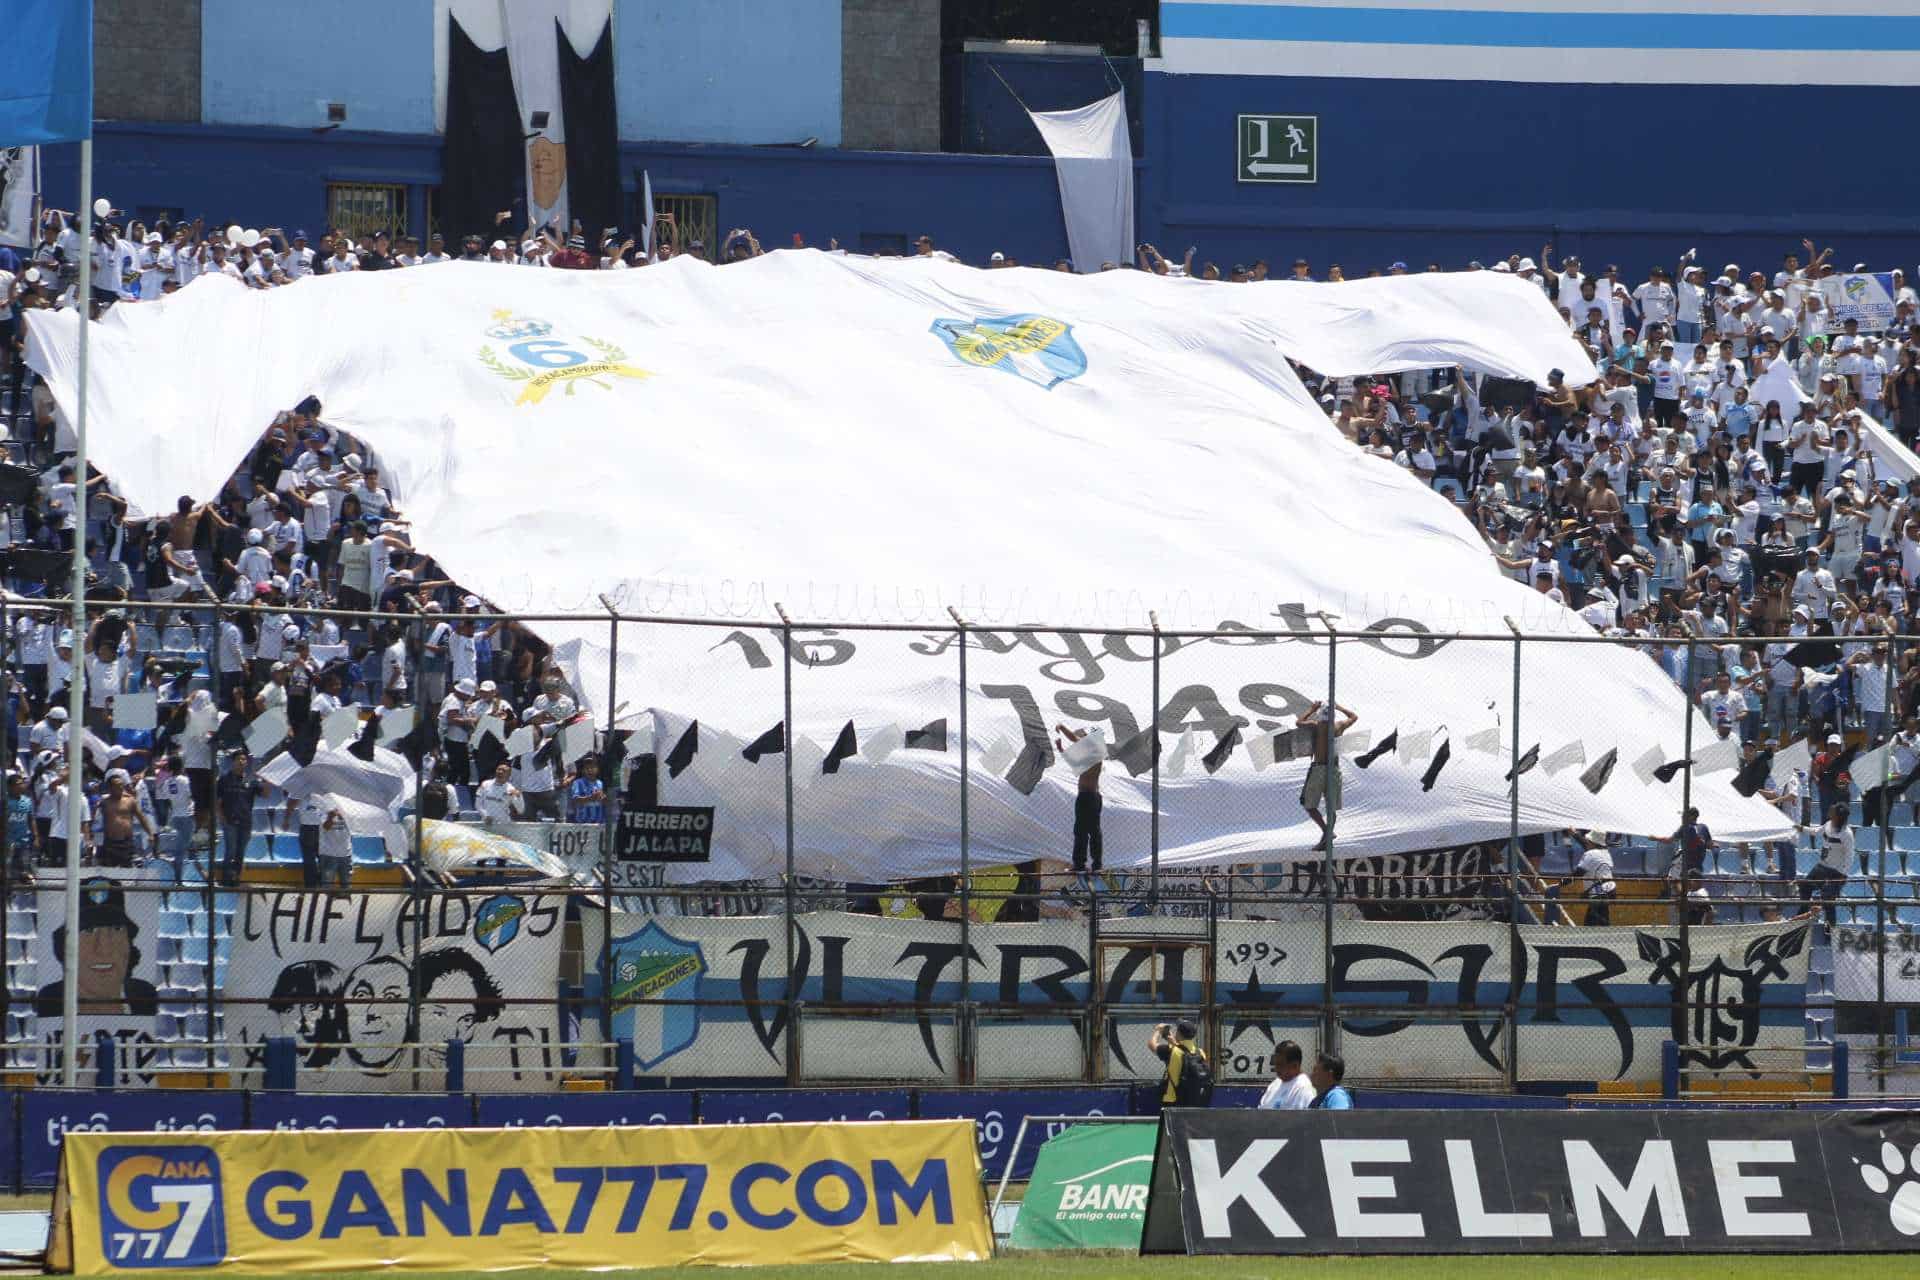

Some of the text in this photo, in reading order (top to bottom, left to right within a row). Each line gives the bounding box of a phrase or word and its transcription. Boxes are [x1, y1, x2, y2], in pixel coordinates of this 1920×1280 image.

[508, 340, 588, 368] 6
[708, 625, 856, 669] 16
[622, 811, 709, 831] TERRERO
[550, 831, 588, 857] HOY
[625, 835, 705, 854] JALAPA
[1225, 942, 1287, 967] 1997
[245, 1158, 955, 1241] GANA777.COM
[1188, 1138, 1812, 1238] KELME
[1056, 1211, 1066, 1220] El
[1069, 1211, 1103, 1221] amigo
[1106, 1211, 1127, 1221] que
